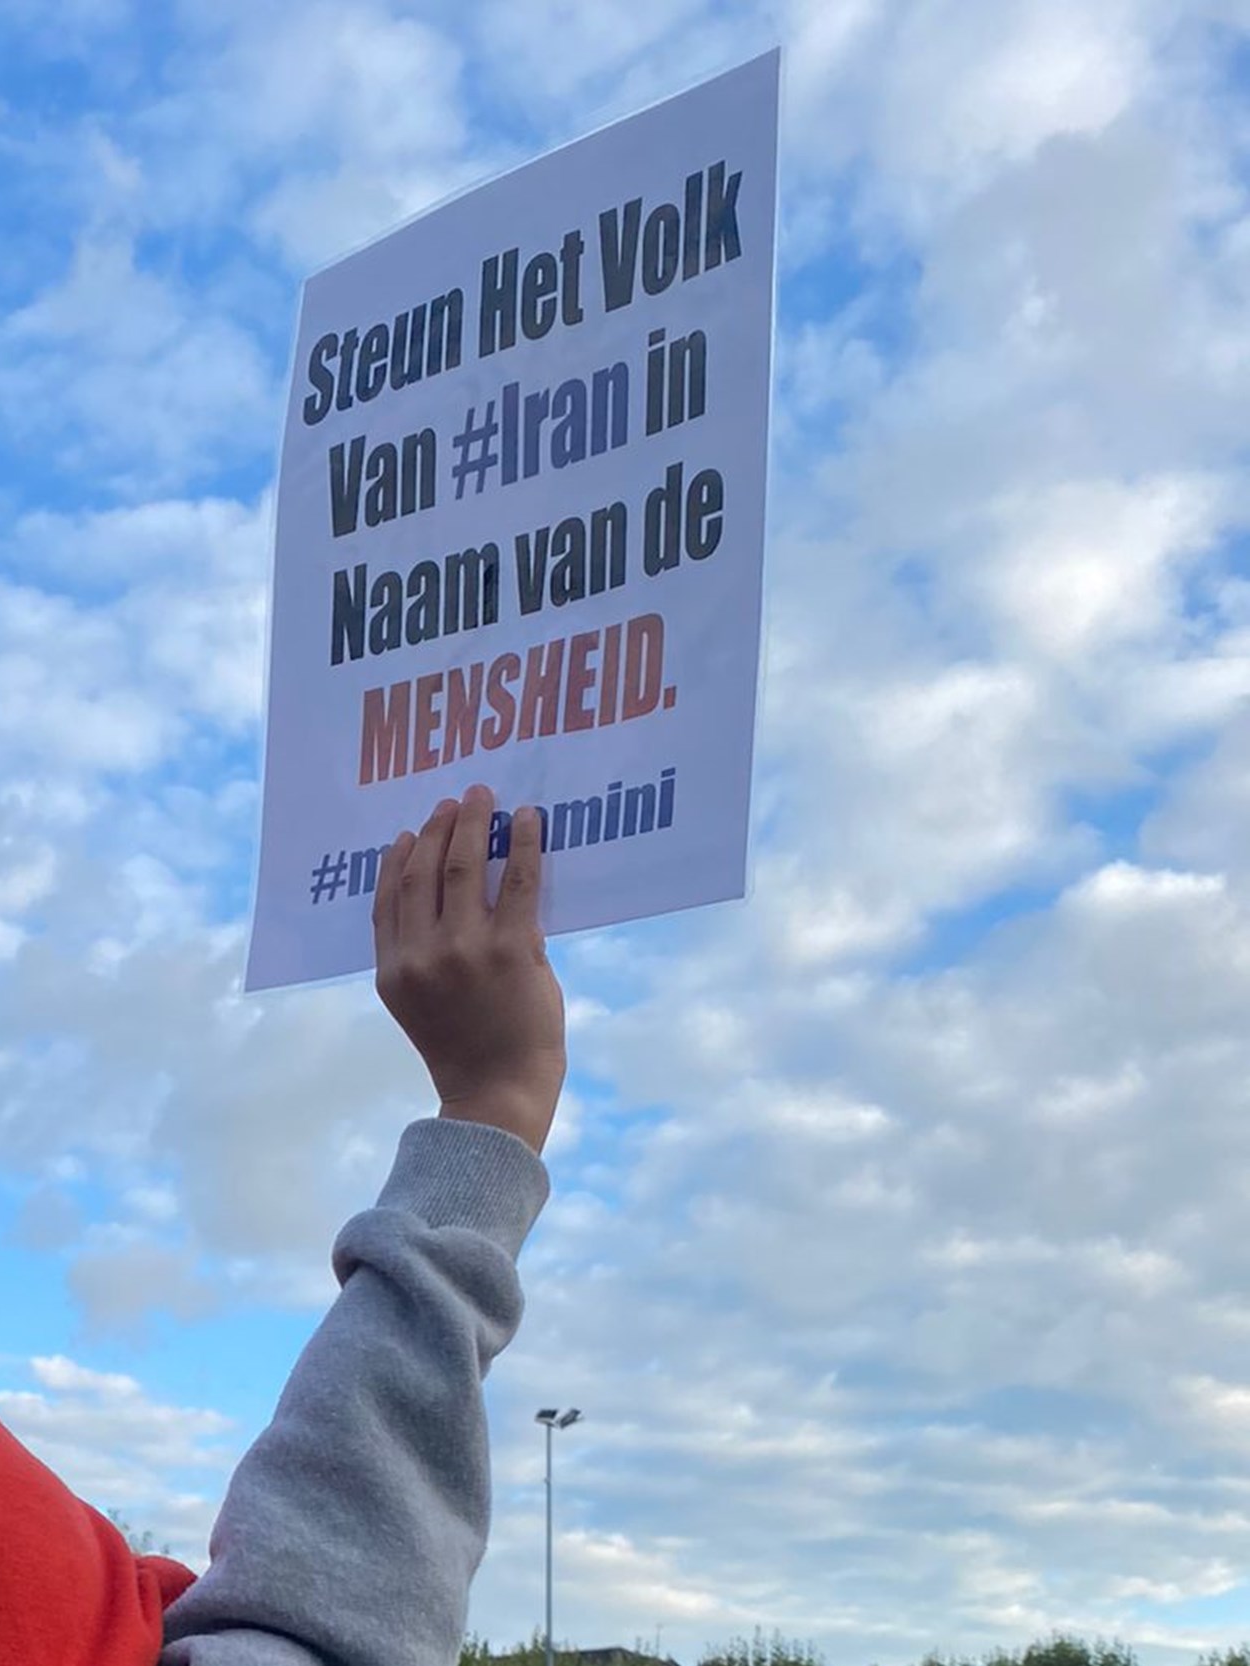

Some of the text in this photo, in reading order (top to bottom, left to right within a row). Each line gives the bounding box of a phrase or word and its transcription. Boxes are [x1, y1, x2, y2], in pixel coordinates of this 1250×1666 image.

[303, 160, 743, 427] Steun Het Volk
[329, 328, 707, 538] Van #Iran in
[330, 461, 724, 666] Naam van de
[358, 612, 678, 786] MENSHEID.
